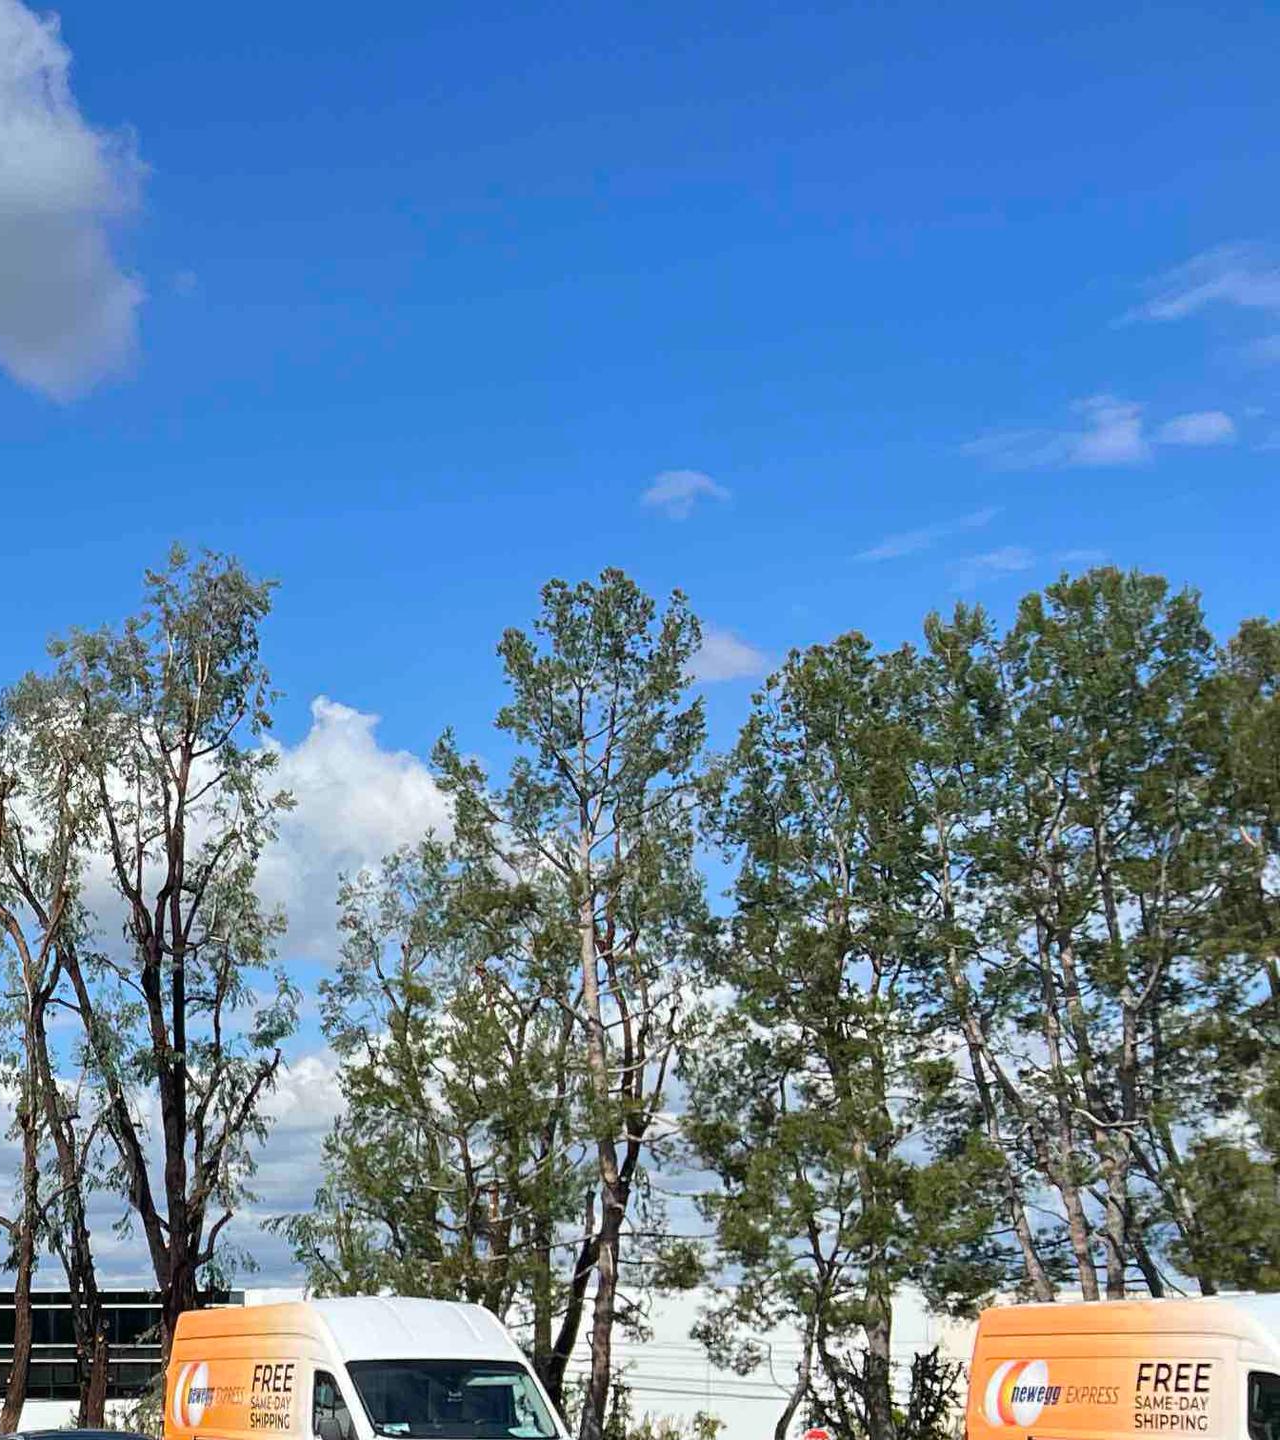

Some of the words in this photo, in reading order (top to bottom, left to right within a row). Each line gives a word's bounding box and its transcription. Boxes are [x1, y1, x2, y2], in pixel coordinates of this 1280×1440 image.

[251, 1364, 295, 1392] FREE
[1136, 1363, 1212, 1393] FREE
[250, 1396, 291, 1411] SAME-DAY
[1011, 1386, 1061, 1405] newegg
[1065, 1386, 1120, 1404] EXPRESS
[1134, 1396, 1209, 1411] SAME-DAY
[250, 1413, 290, 1430] SHIPPING
[1134, 1413, 1208, 1431] SHIPPING
